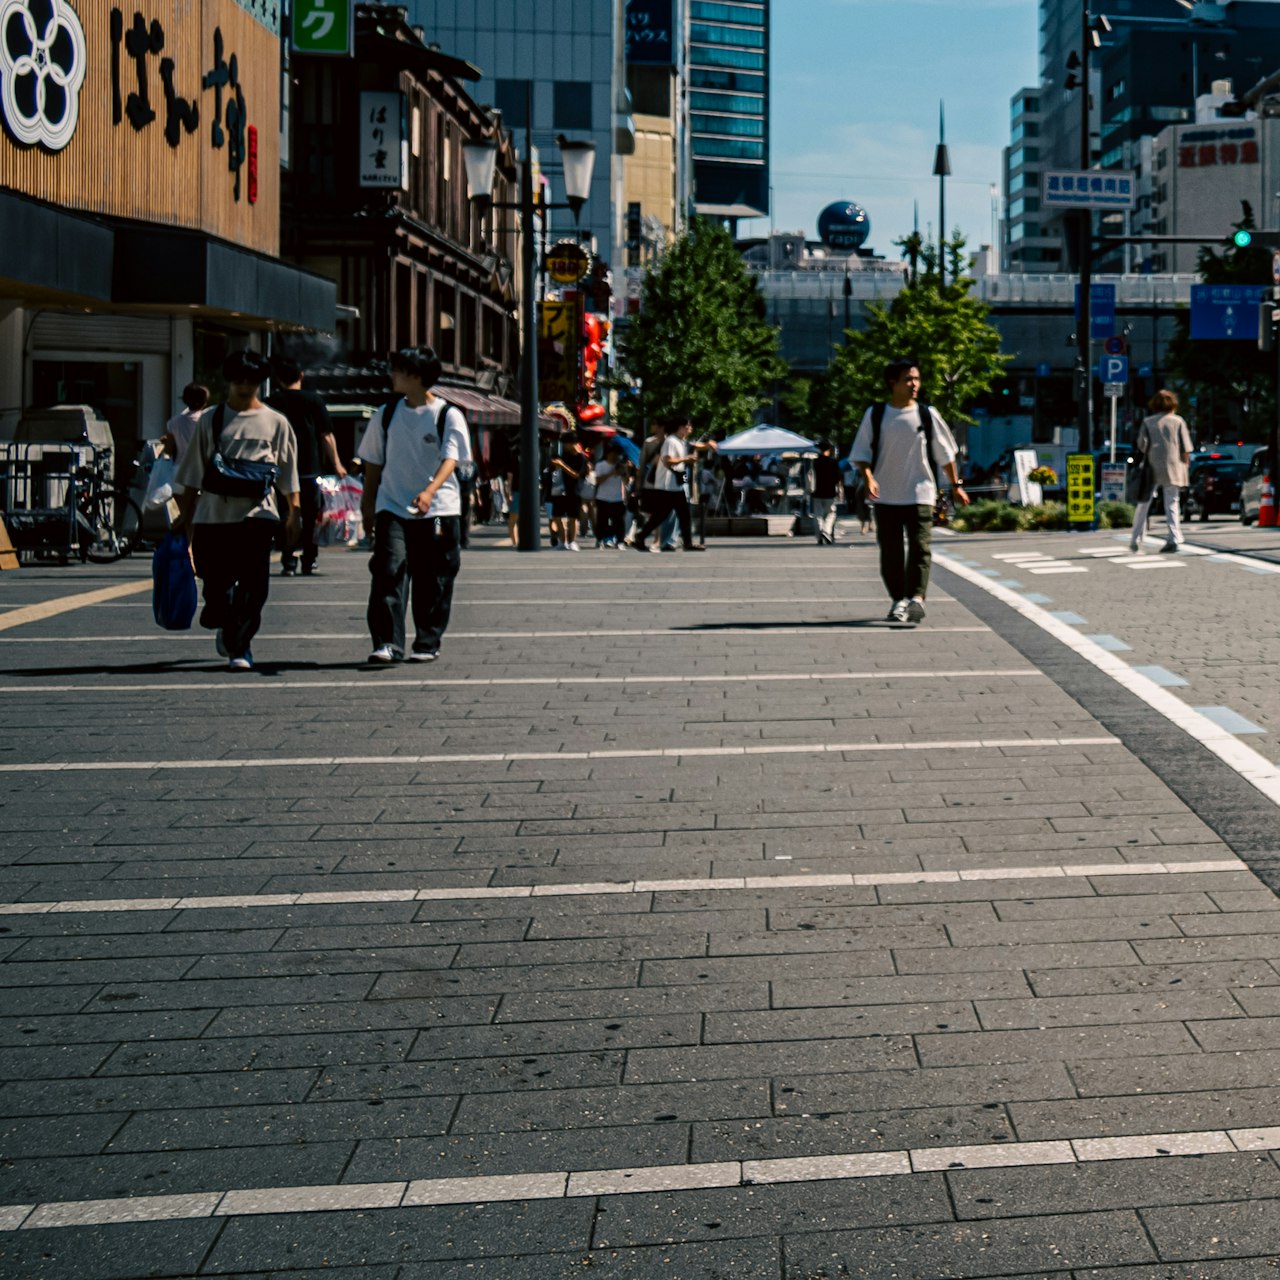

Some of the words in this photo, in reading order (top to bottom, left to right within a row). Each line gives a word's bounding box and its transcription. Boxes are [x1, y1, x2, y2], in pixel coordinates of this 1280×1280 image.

[369, 104, 388, 169] はり重
[1108, 360, 1123, 380] P
